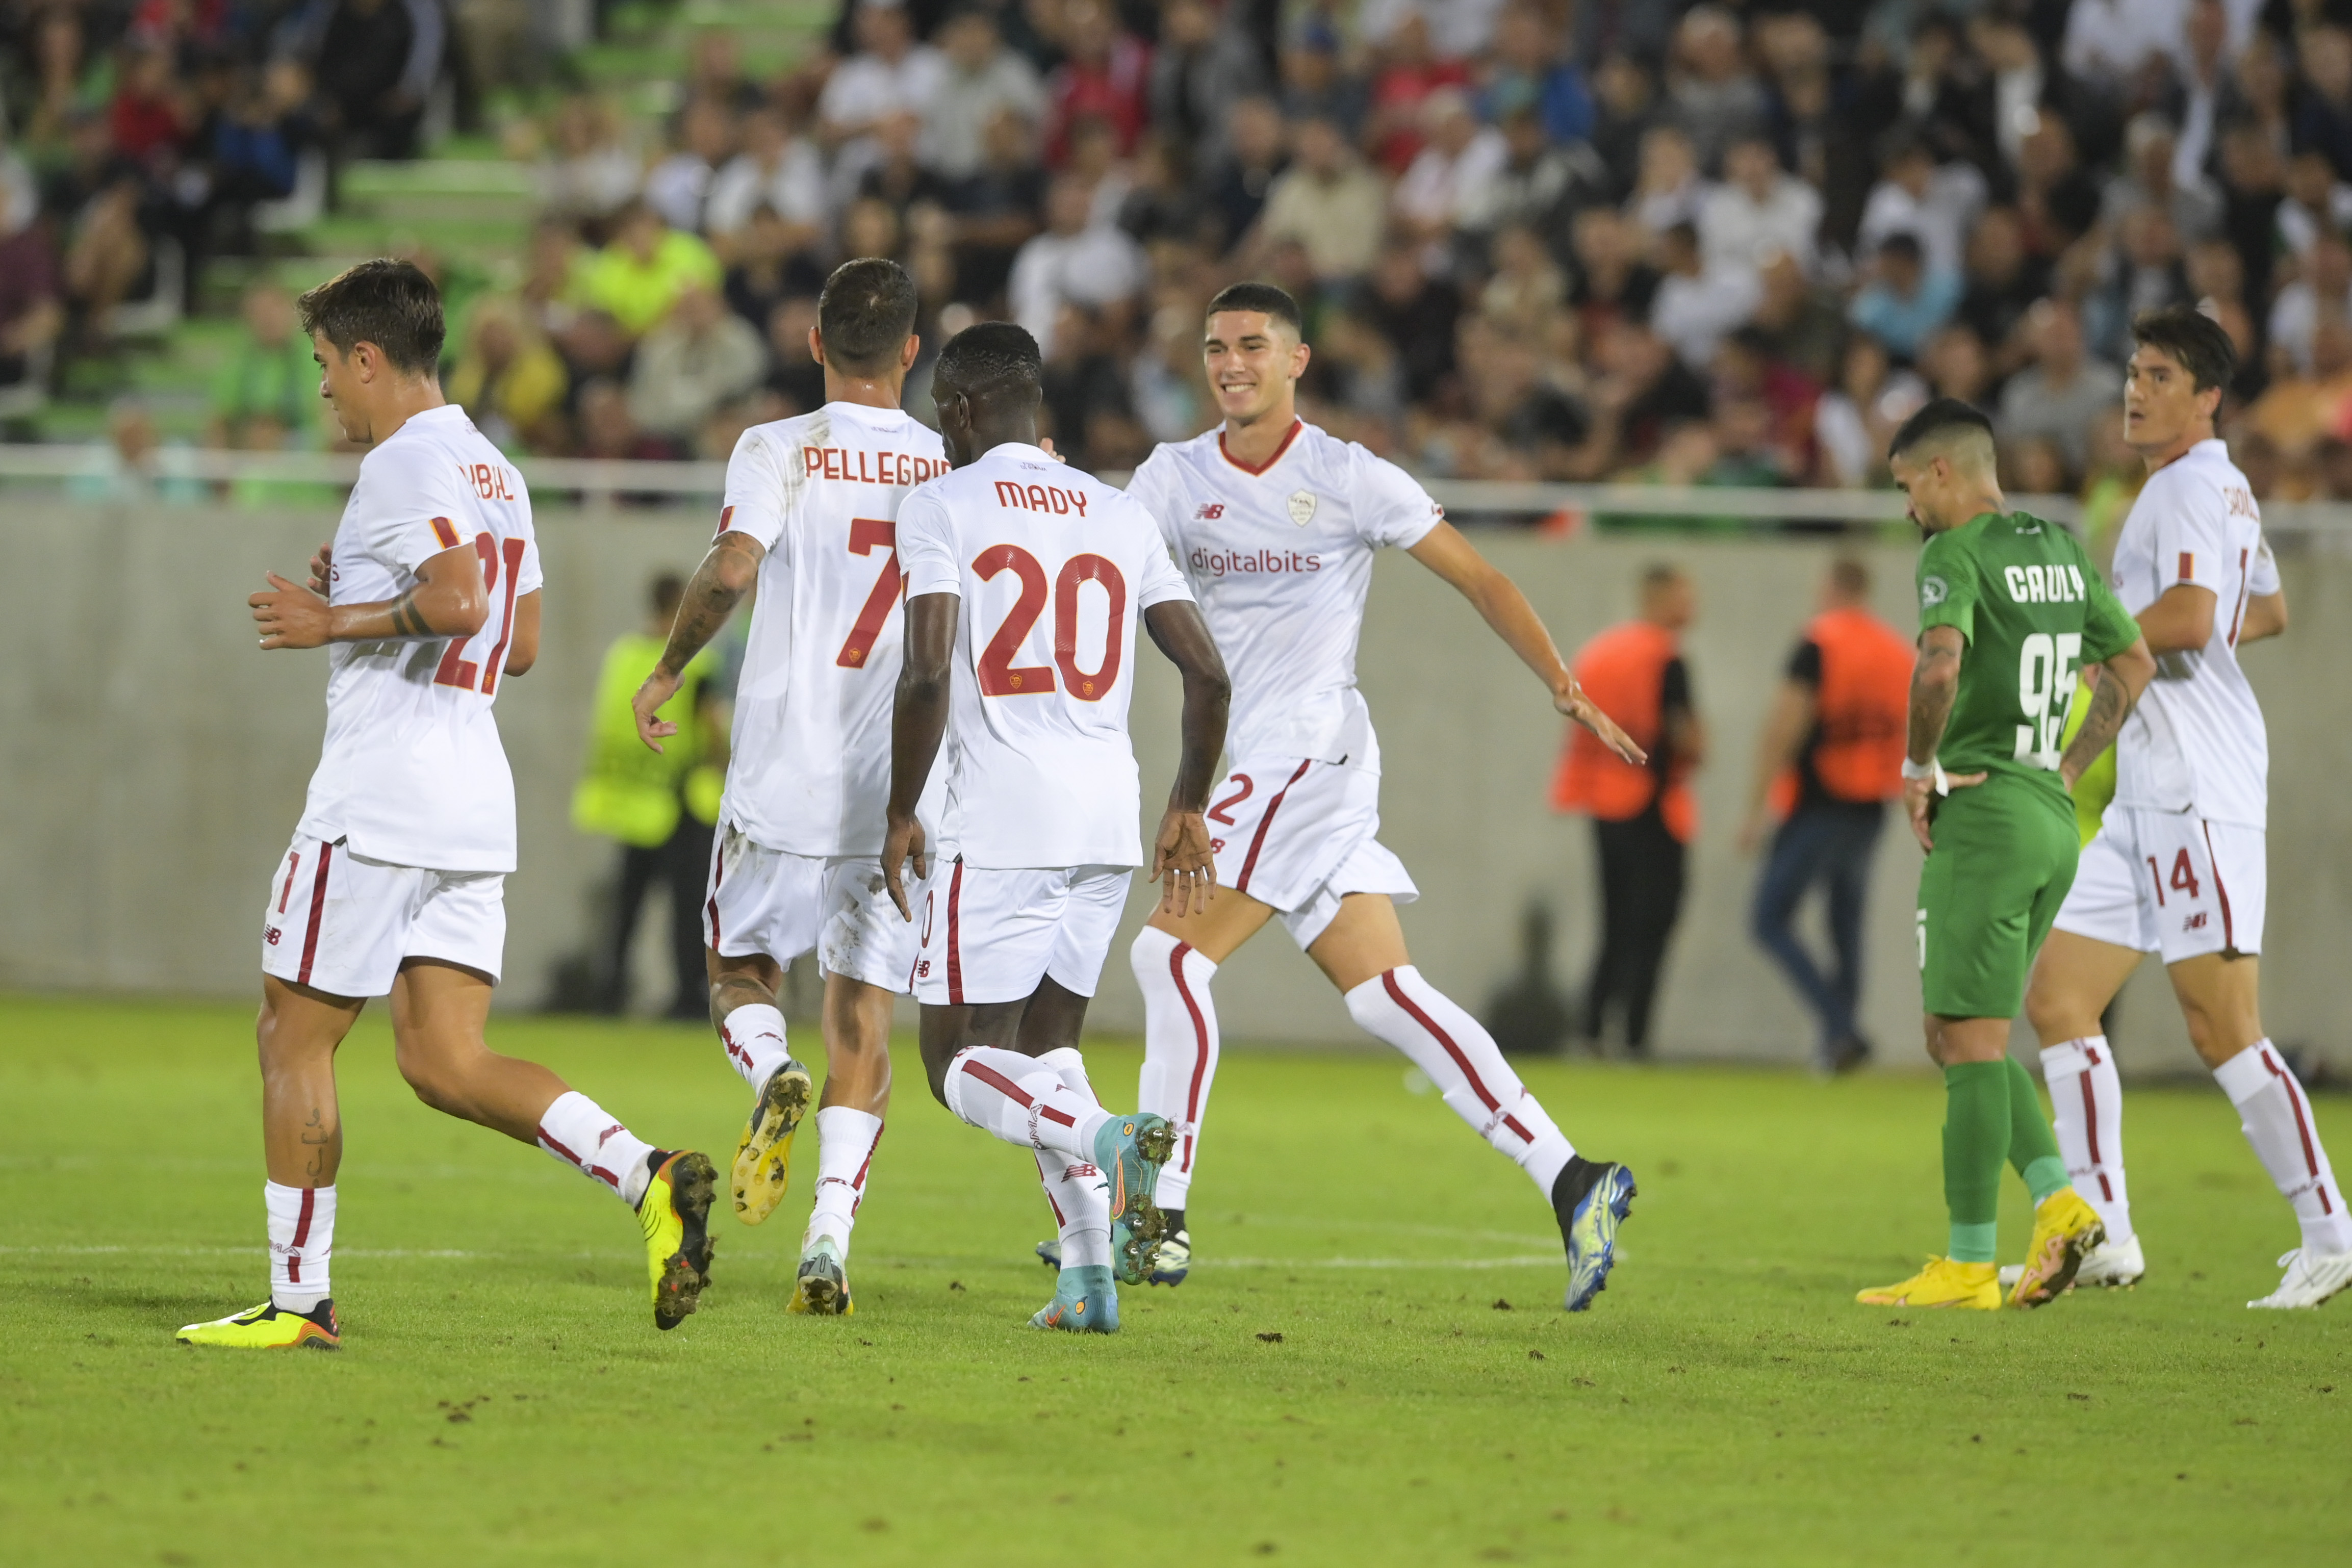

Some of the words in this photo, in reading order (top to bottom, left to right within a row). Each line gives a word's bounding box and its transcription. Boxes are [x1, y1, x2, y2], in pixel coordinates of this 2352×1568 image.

[994, 481, 1087, 518] MADY
[1191, 548, 1321, 577] digitalbits
[2004, 564, 2085, 603] CAULY
[433, 531, 526, 696] 21
[836, 517, 902, 670] 7
[971, 544, 1126, 702] 20
[2013, 632, 2083, 772] 95
[1207, 773, 1254, 826] 2
[1210, 838, 1226, 854] B
[2146, 845, 2199, 907] 14
[278, 851, 300, 914] 1
[921, 889, 933, 948] 0
